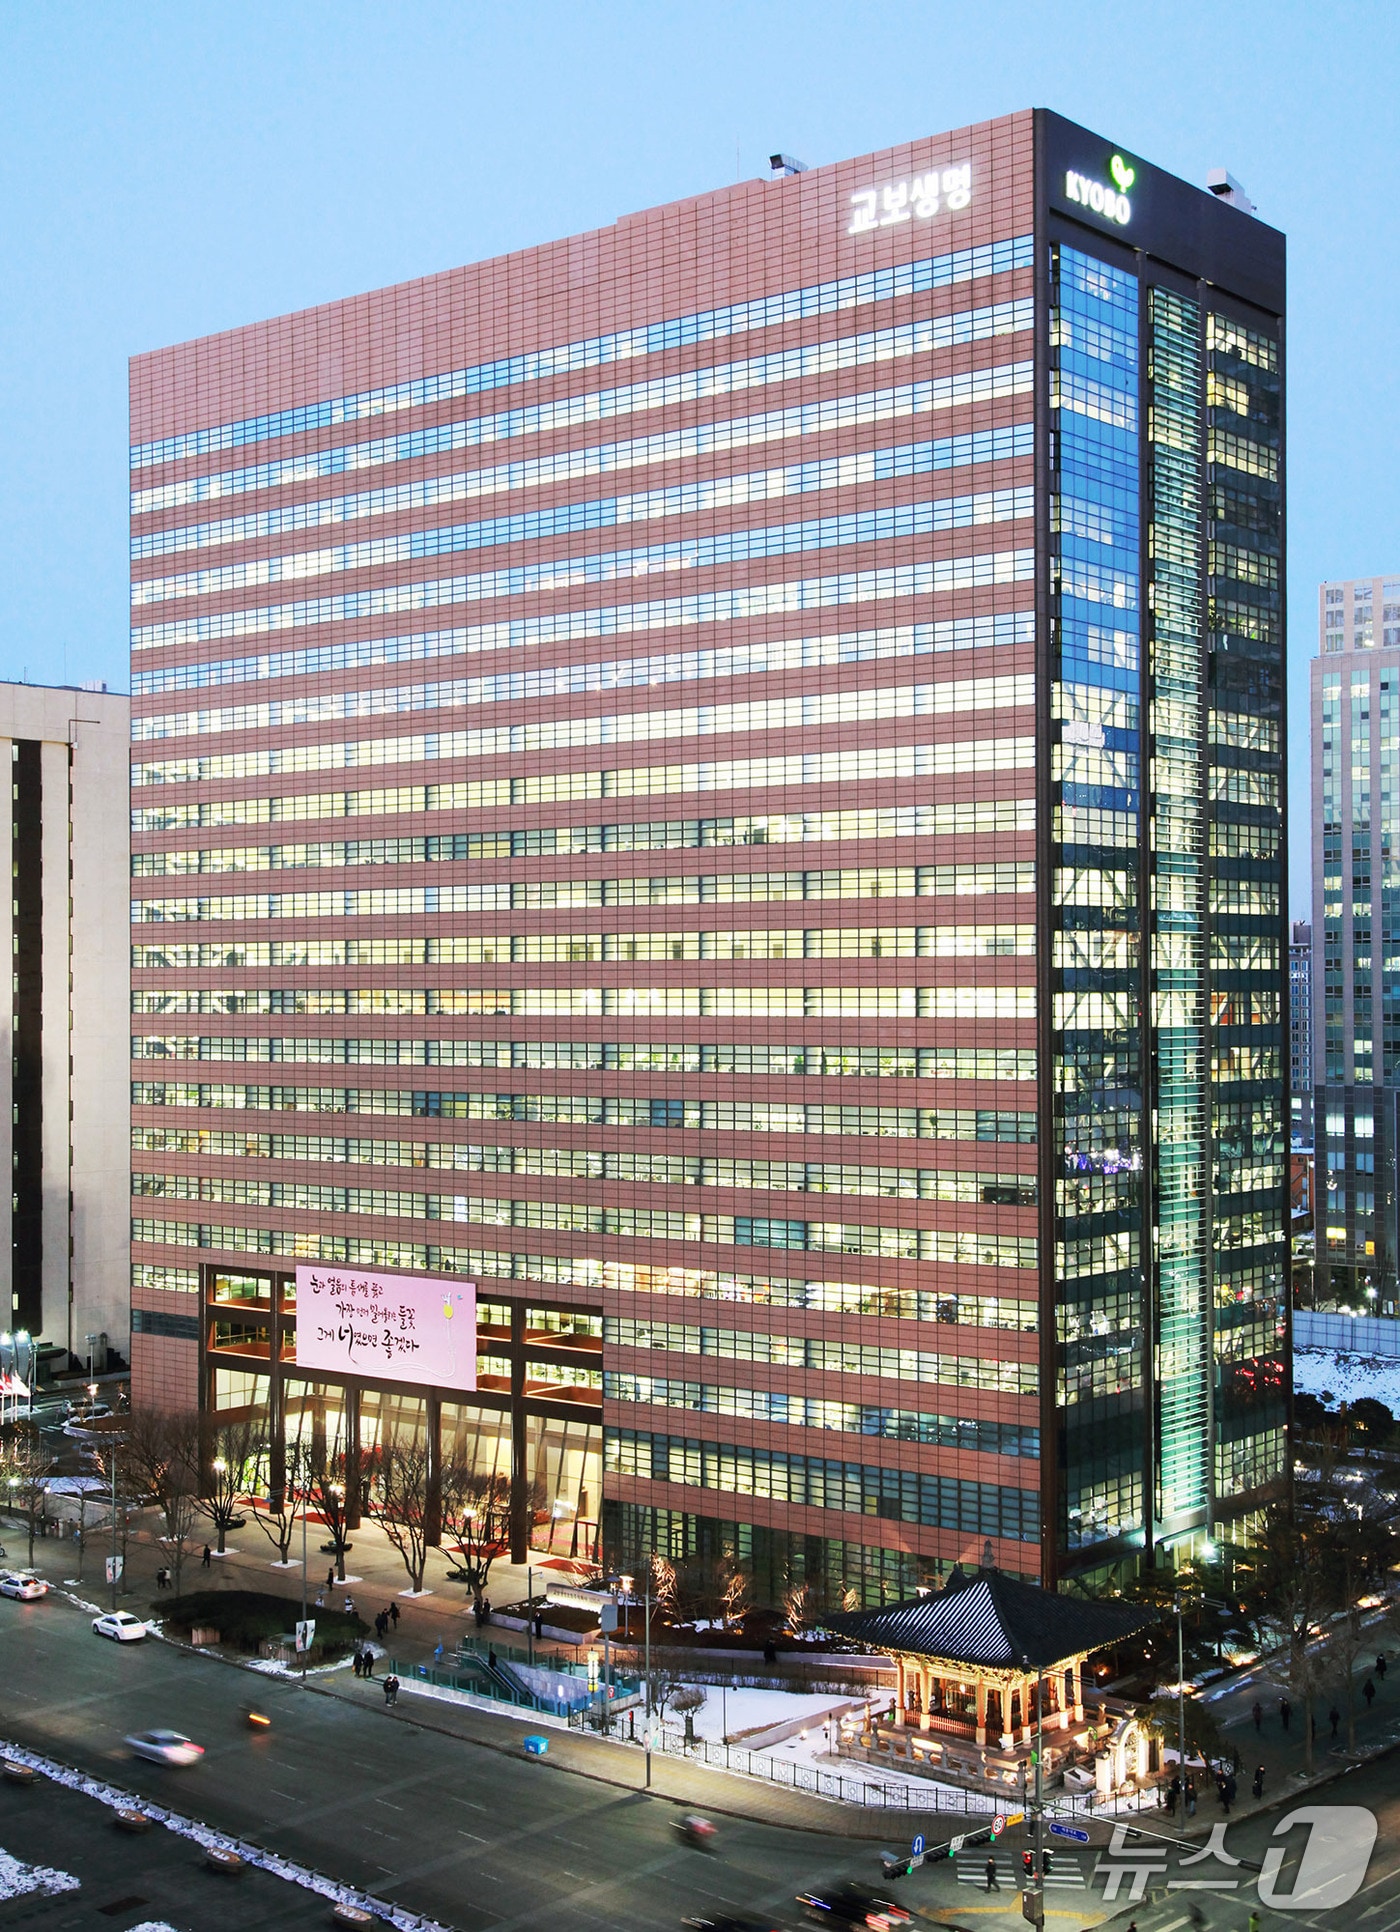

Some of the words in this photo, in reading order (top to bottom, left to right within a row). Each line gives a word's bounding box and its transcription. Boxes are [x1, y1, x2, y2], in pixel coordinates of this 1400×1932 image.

[848, 163, 972, 233] 교보생명
[1065, 169, 1131, 225] KYOBO
[310, 1274, 326, 1294] 눈과
[327, 1277, 347, 1296] 얼음의
[335, 1301, 355, 1318] 가장
[398, 1305, 416, 1330] 들꽃
[317, 1327, 335, 1342] 그게
[338, 1323, 378, 1364] 너였으면
[381, 1329, 420, 1359] 좋겠다
